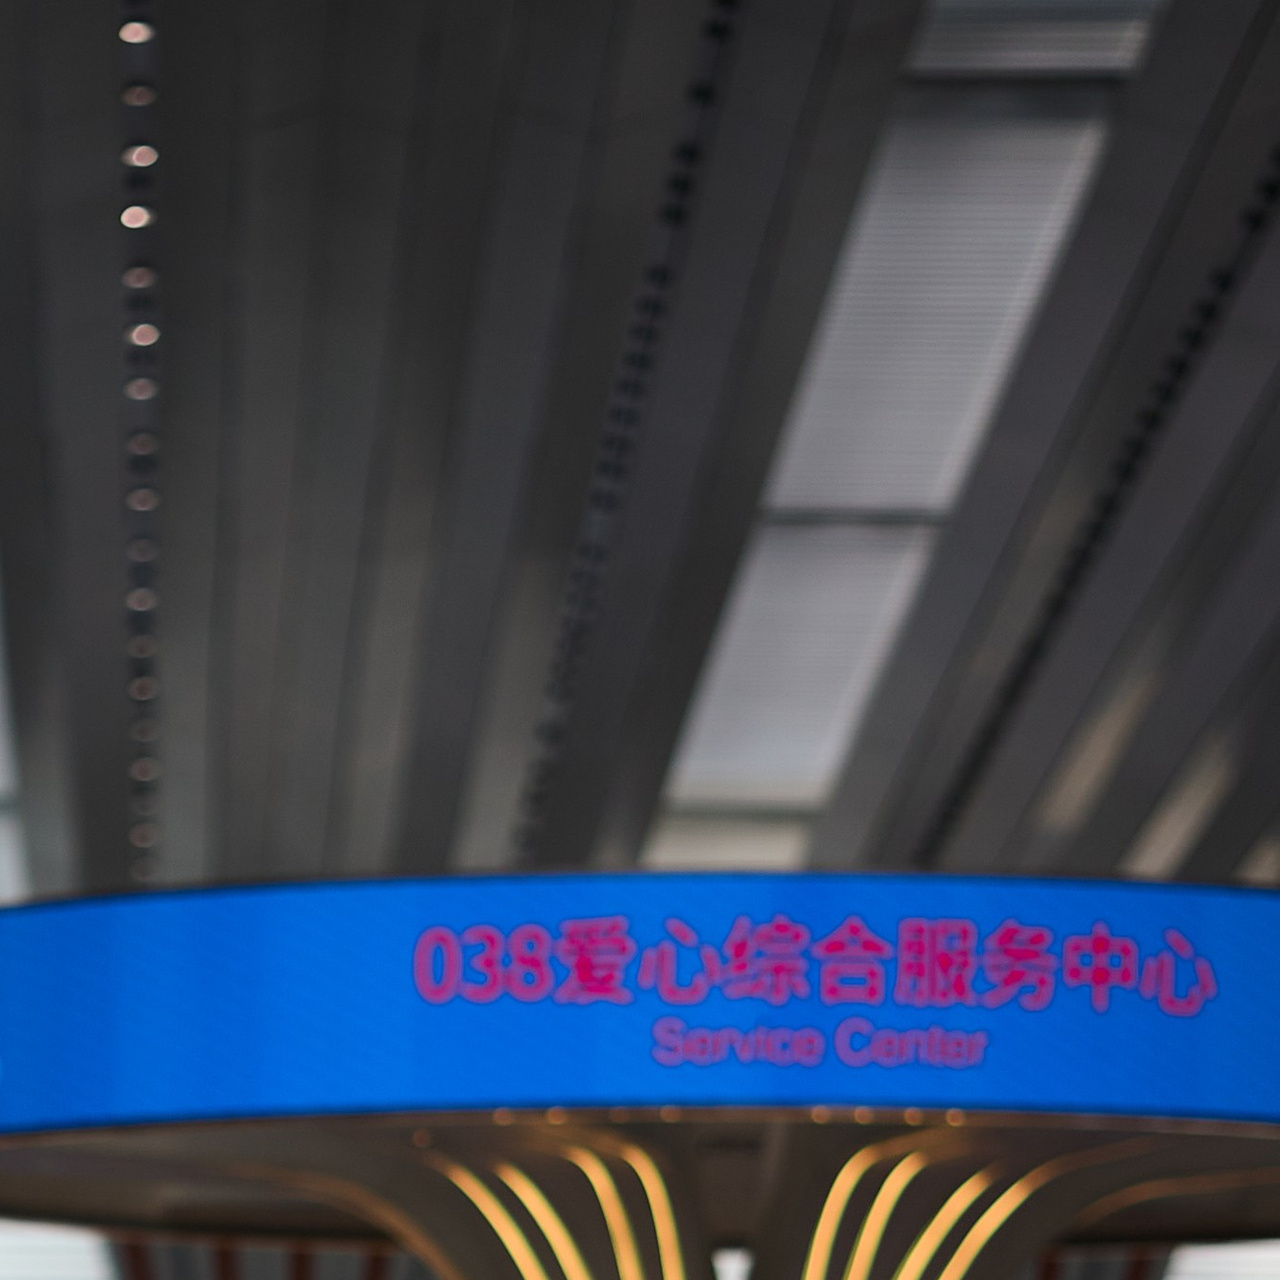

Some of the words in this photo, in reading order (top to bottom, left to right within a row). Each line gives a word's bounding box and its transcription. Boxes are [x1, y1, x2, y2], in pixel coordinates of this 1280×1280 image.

[413, 914, 1218, 1017] 038爱心综合服务中心
[652, 1015, 826, 1068] Service
[834, 1015, 988, 1069] Center
